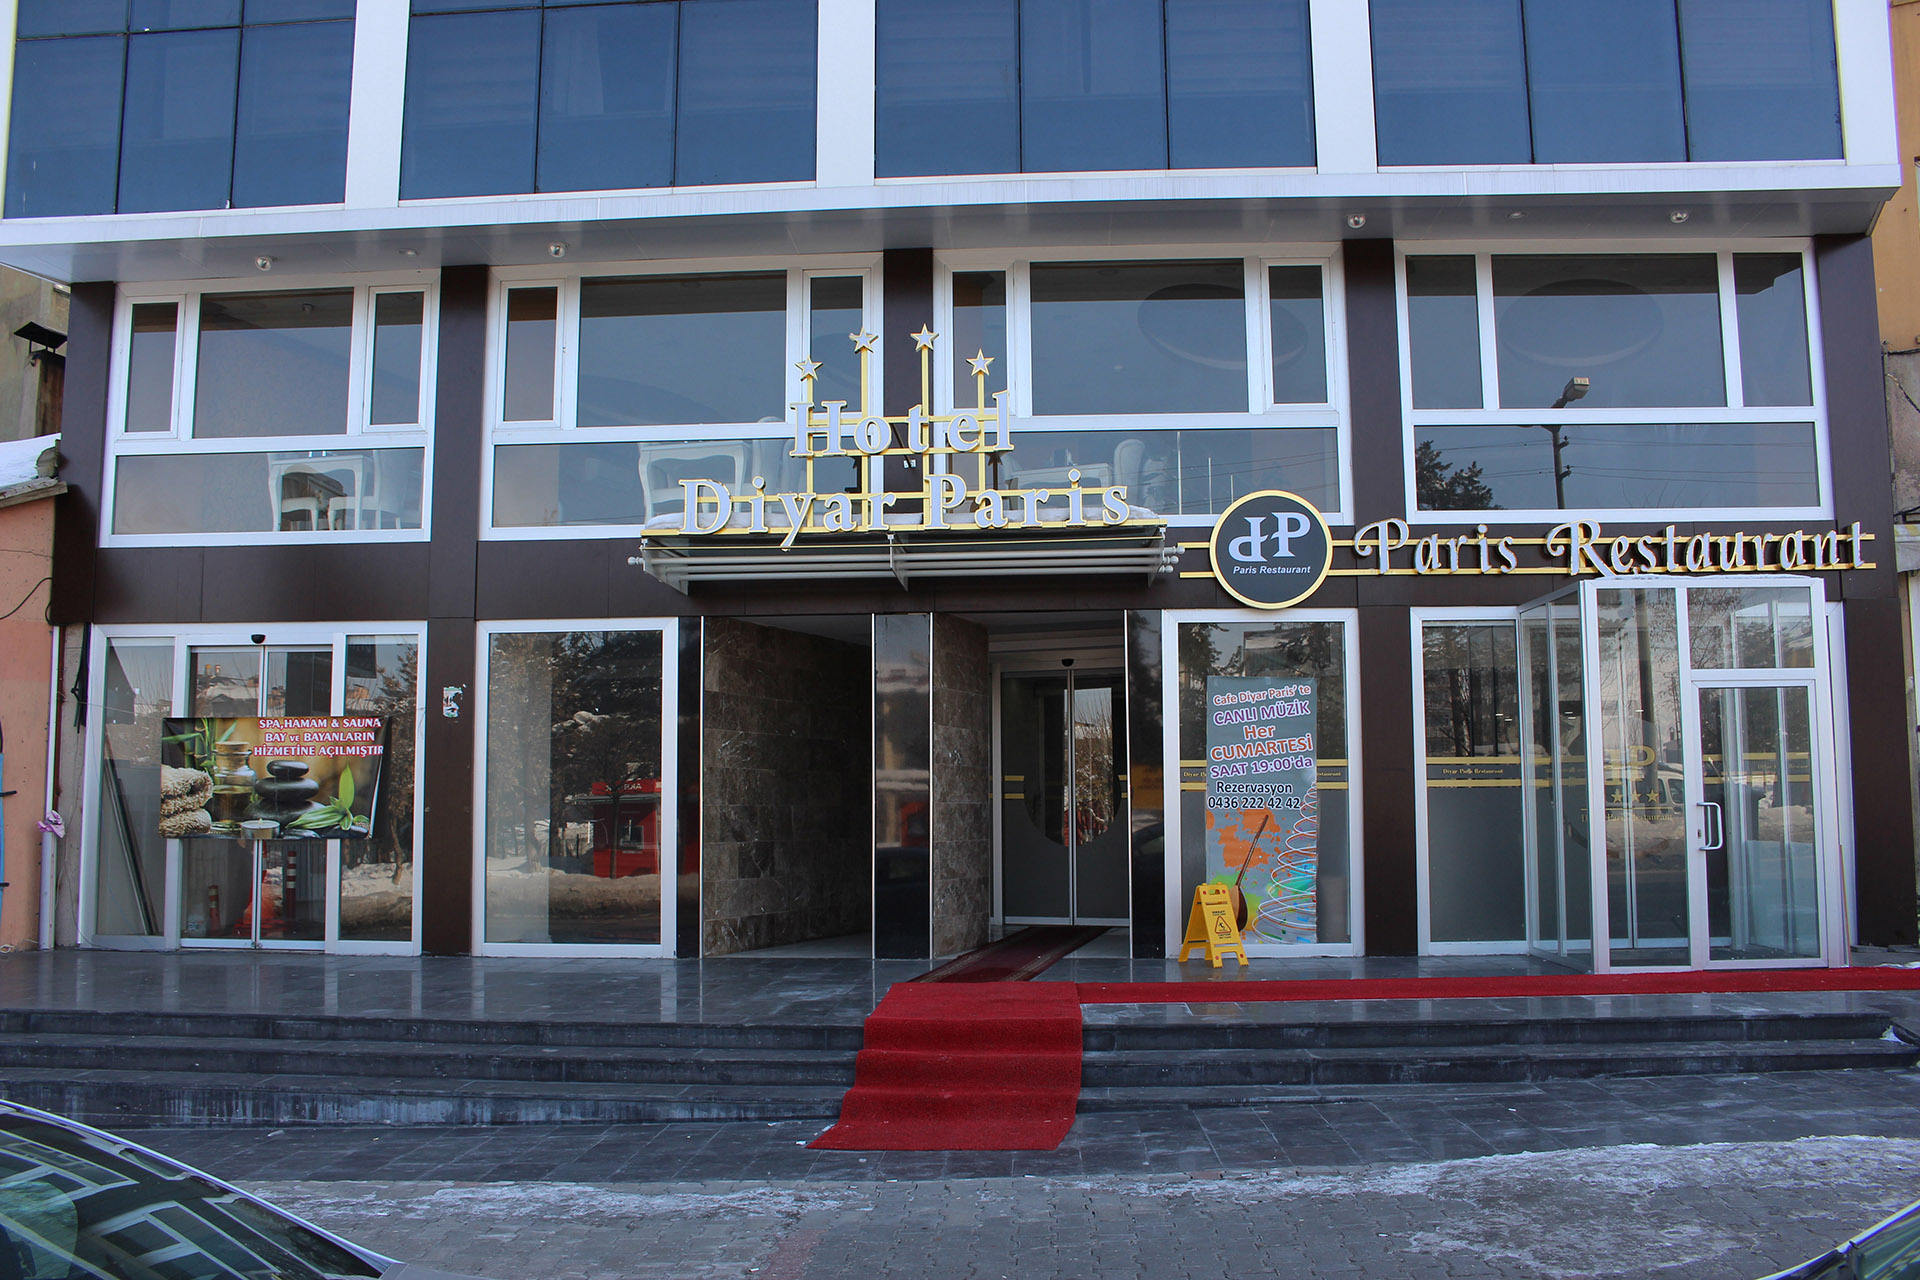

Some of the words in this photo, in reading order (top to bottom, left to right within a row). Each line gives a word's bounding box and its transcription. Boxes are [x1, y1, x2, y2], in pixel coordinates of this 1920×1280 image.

[789, 390, 1014, 457] Hotel
[678, 475, 897, 552] Diyar
[923, 468, 1131, 530] Paris
[1354, 518, 1517, 575] Paris
[1545, 519, 1867, 577] Restaurant
[1233, 566, 1257, 574] Paris
[1259, 565, 1311, 574] Restaurant
[1214, 693, 1237, 706] Cafe
[1239, 691, 1267, 704] Diyar
[1299, 685, 1311, 695] te
[1214, 707, 1257, 725] CANLI
[1260, 700, 1310, 720] MÜZİK
[331, 719, 340, 728] &
[343, 717, 382, 728] SAUNA
[265, 732, 287, 742] BAY
[303, 732, 375, 742] BAYANLARIN
[1243, 725, 1275, 740] Her
[254, 744, 316, 756] HİZMETİNE
[318, 745, 384, 758] AÇILMIŞTIR
[1211, 734, 1313, 760] CUMARTESİ
[1211, 763, 1247, 778] SAAT
[1252, 756, 1313, 774] 19:00'da
[1216, 781, 1293, 795] Rezervasyon
[1208, 797, 1238, 809] 0436
[1242, 797, 1264, 809] 222
[1267, 797, 1282, 809] 42
[1285, 797, 1300, 809] 42
